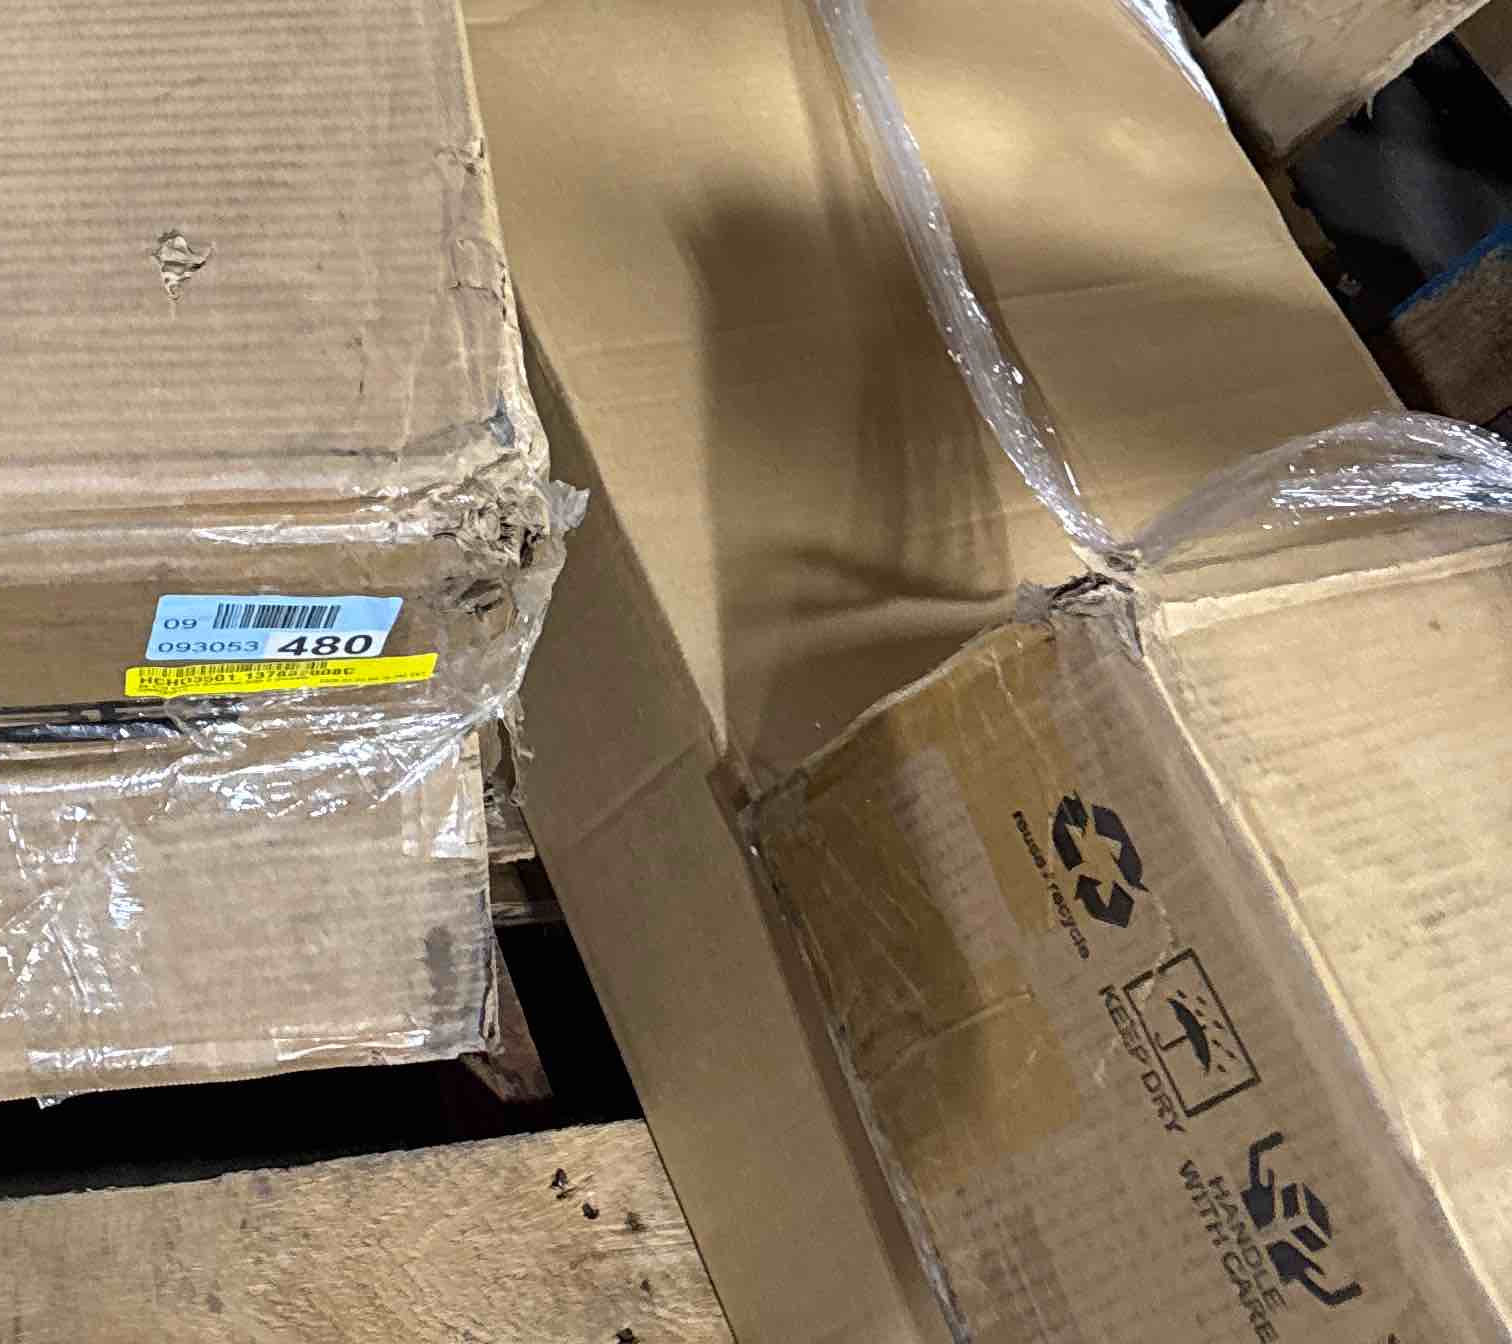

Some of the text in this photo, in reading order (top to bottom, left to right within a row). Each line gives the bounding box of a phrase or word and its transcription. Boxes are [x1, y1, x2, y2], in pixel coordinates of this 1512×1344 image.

[158, 634, 374, 657] 093053 480
[164, 617, 198, 630] 09
[1099, 985, 1187, 1134] KEEP DRY
[1177, 1159, 1280, 1344] WITH CARE
[1208, 1174, 1289, 1313] HANDLE
